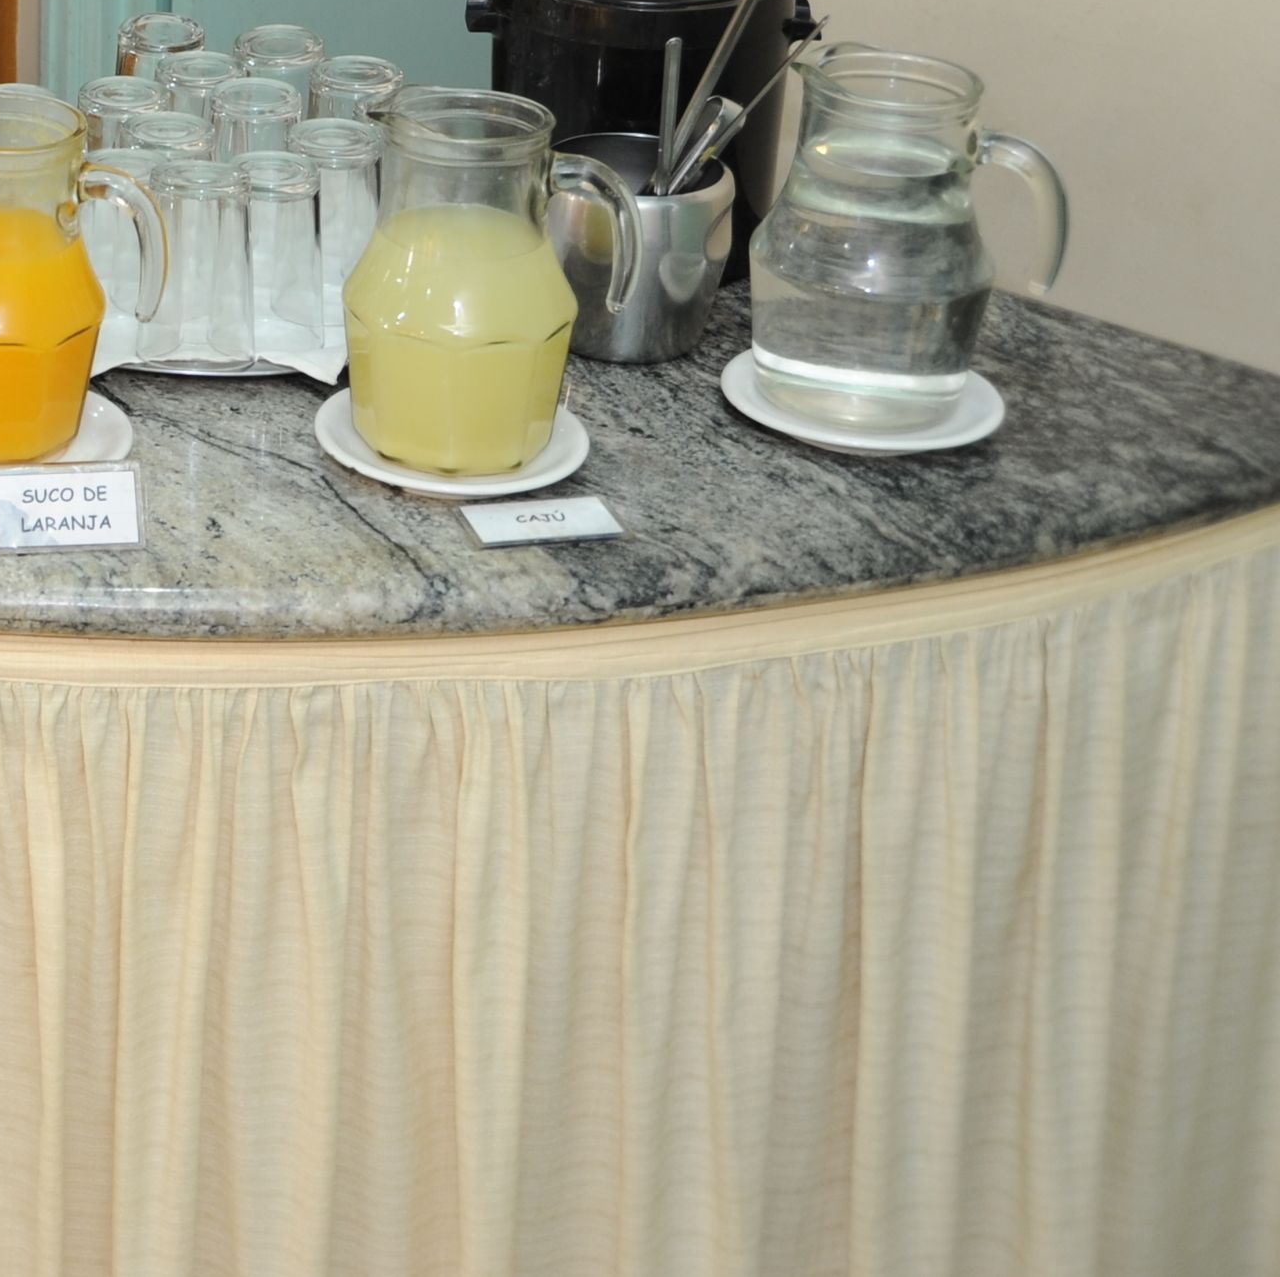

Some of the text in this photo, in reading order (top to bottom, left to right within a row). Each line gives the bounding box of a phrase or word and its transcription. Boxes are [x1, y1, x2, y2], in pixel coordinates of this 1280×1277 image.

[21, 485, 108, 504] SUCO DE
[20, 514, 112, 534] LARANJA
[515, 509, 567, 523] CAJÚ
